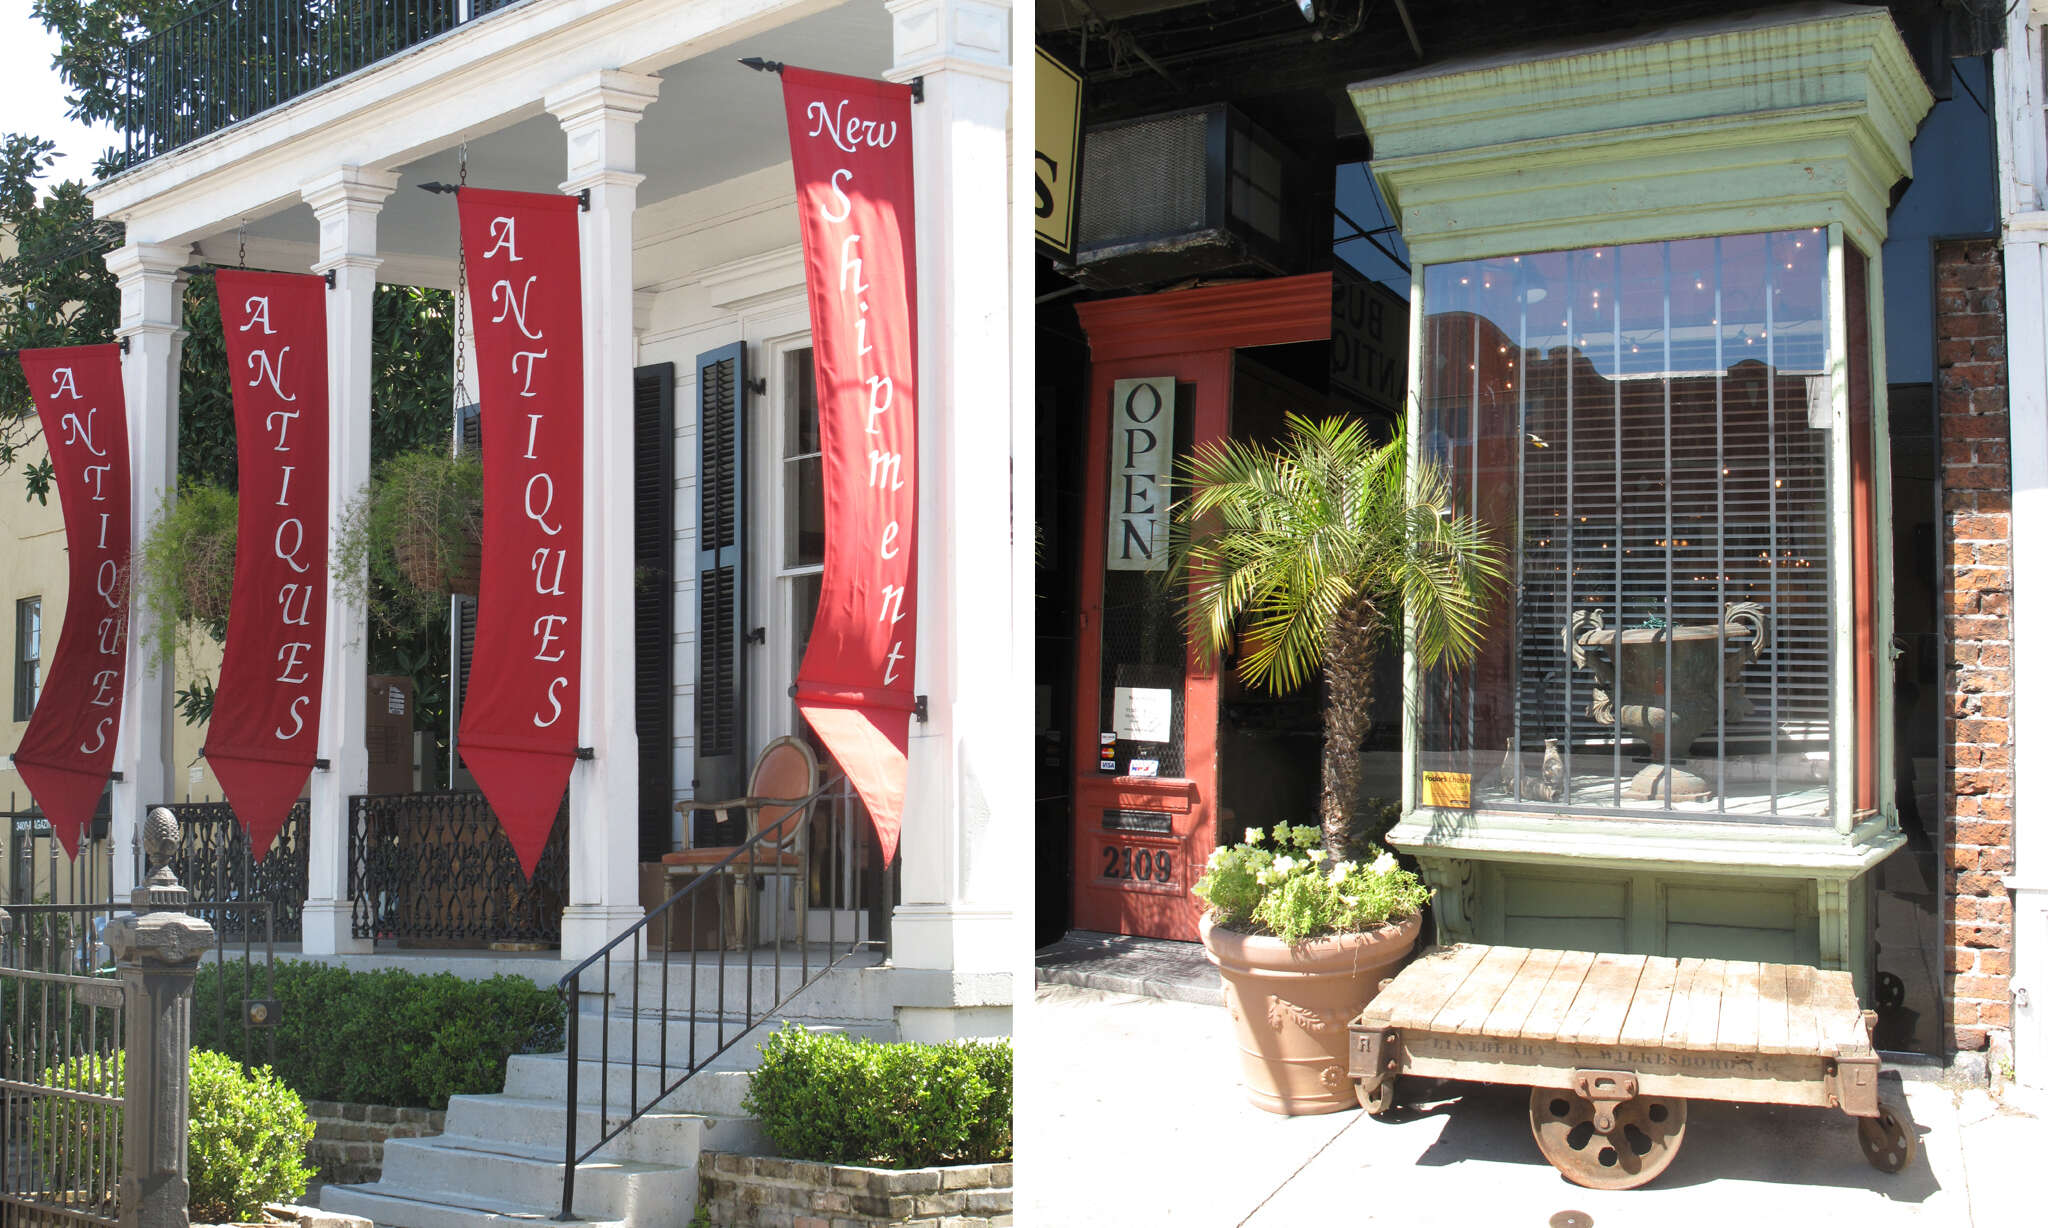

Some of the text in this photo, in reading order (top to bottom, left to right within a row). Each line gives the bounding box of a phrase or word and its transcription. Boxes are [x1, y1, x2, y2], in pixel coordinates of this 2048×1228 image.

[807, 99, 898, 153] New
[50, 367, 119, 754] ANTIQUES
[239, 296, 311, 740] ANTIQUES
[483, 216, 568, 729] ANTIQUES
[820, 168, 906, 686] Shipment
[1120, 383, 1162, 560] OPEN
[1103, 846, 1171, 882] 2109
[1600, 1049, 1735, 1070] WILKESBORO
